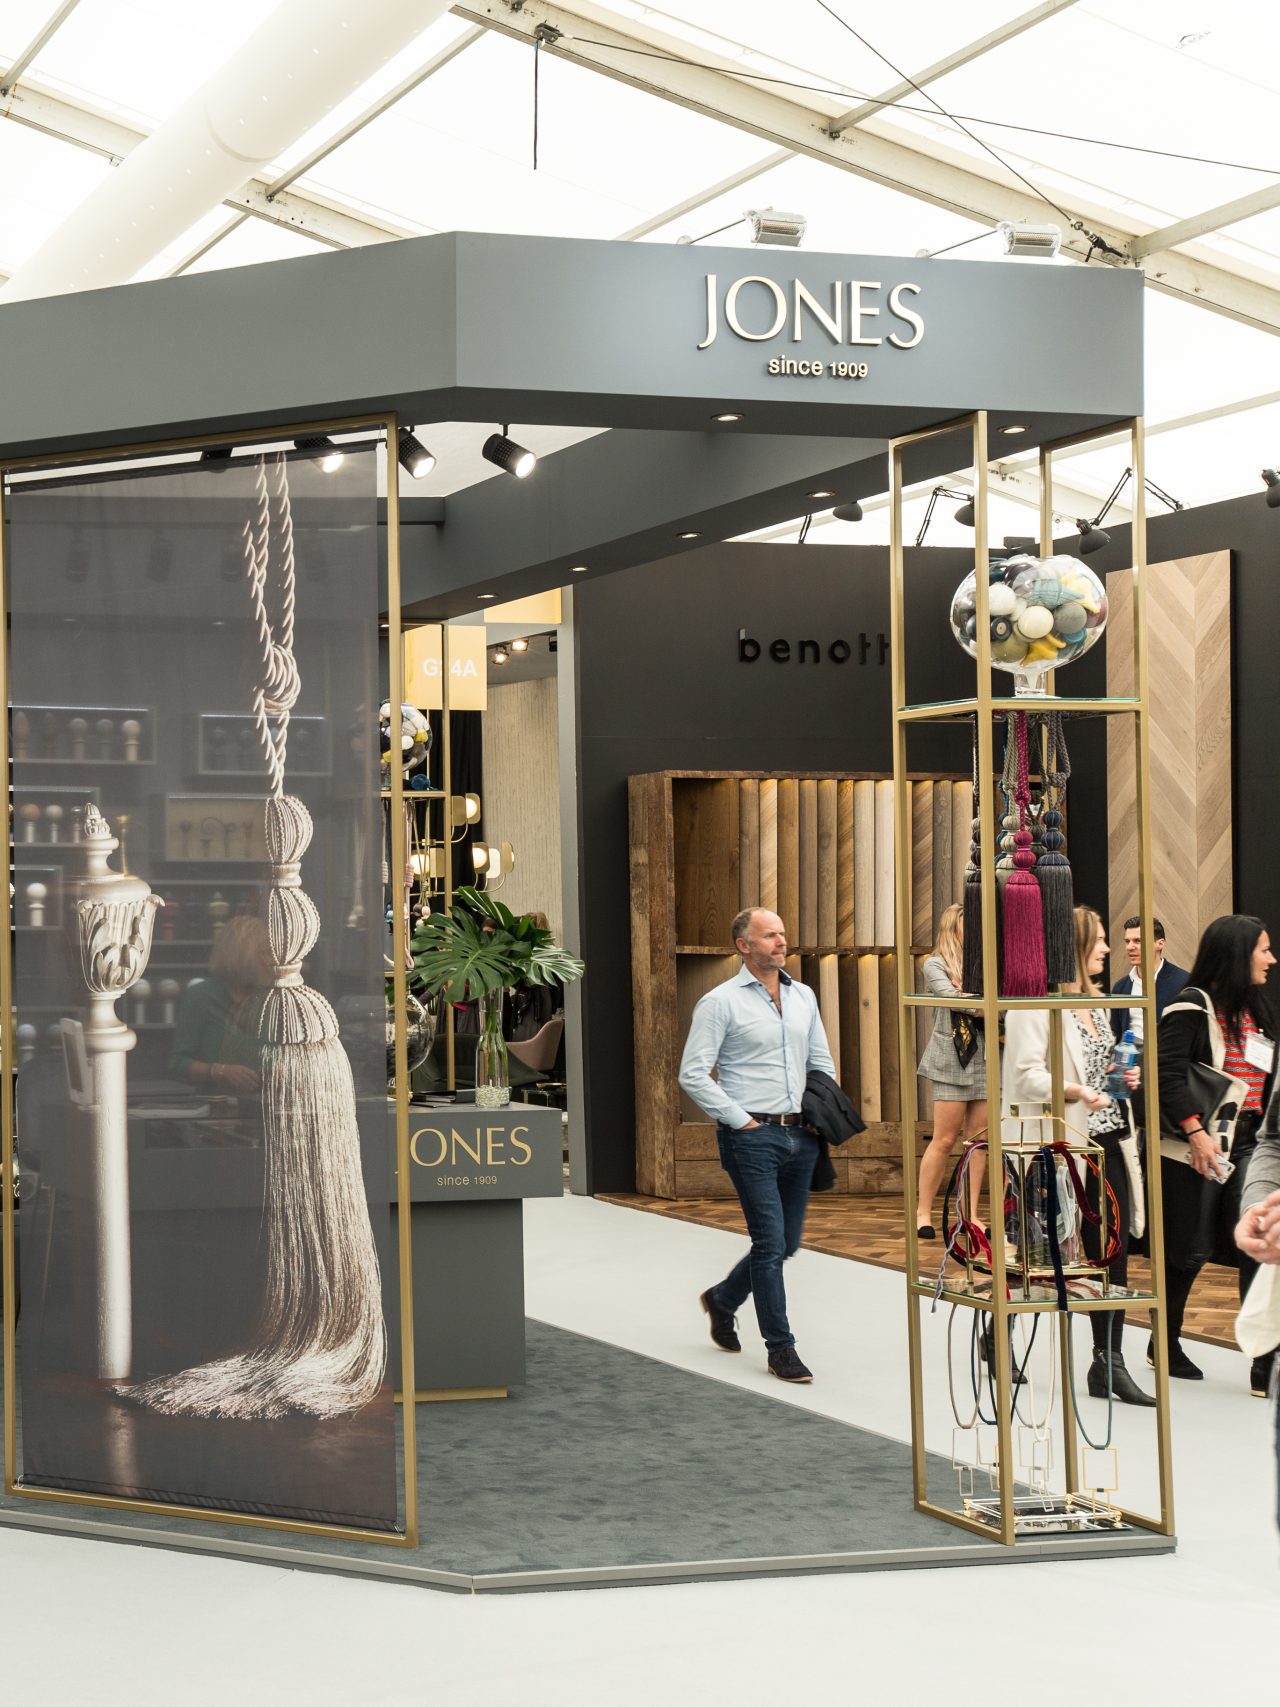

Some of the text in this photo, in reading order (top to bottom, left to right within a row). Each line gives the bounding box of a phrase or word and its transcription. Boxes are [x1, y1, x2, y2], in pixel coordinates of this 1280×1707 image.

[697, 274, 925, 349] JONES
[768, 355, 868, 378] since 1909
[423, 658, 478, 677] G4A
[395, 1126, 532, 1174] ONES
[437, 1175, 498, 1186] since 1909
